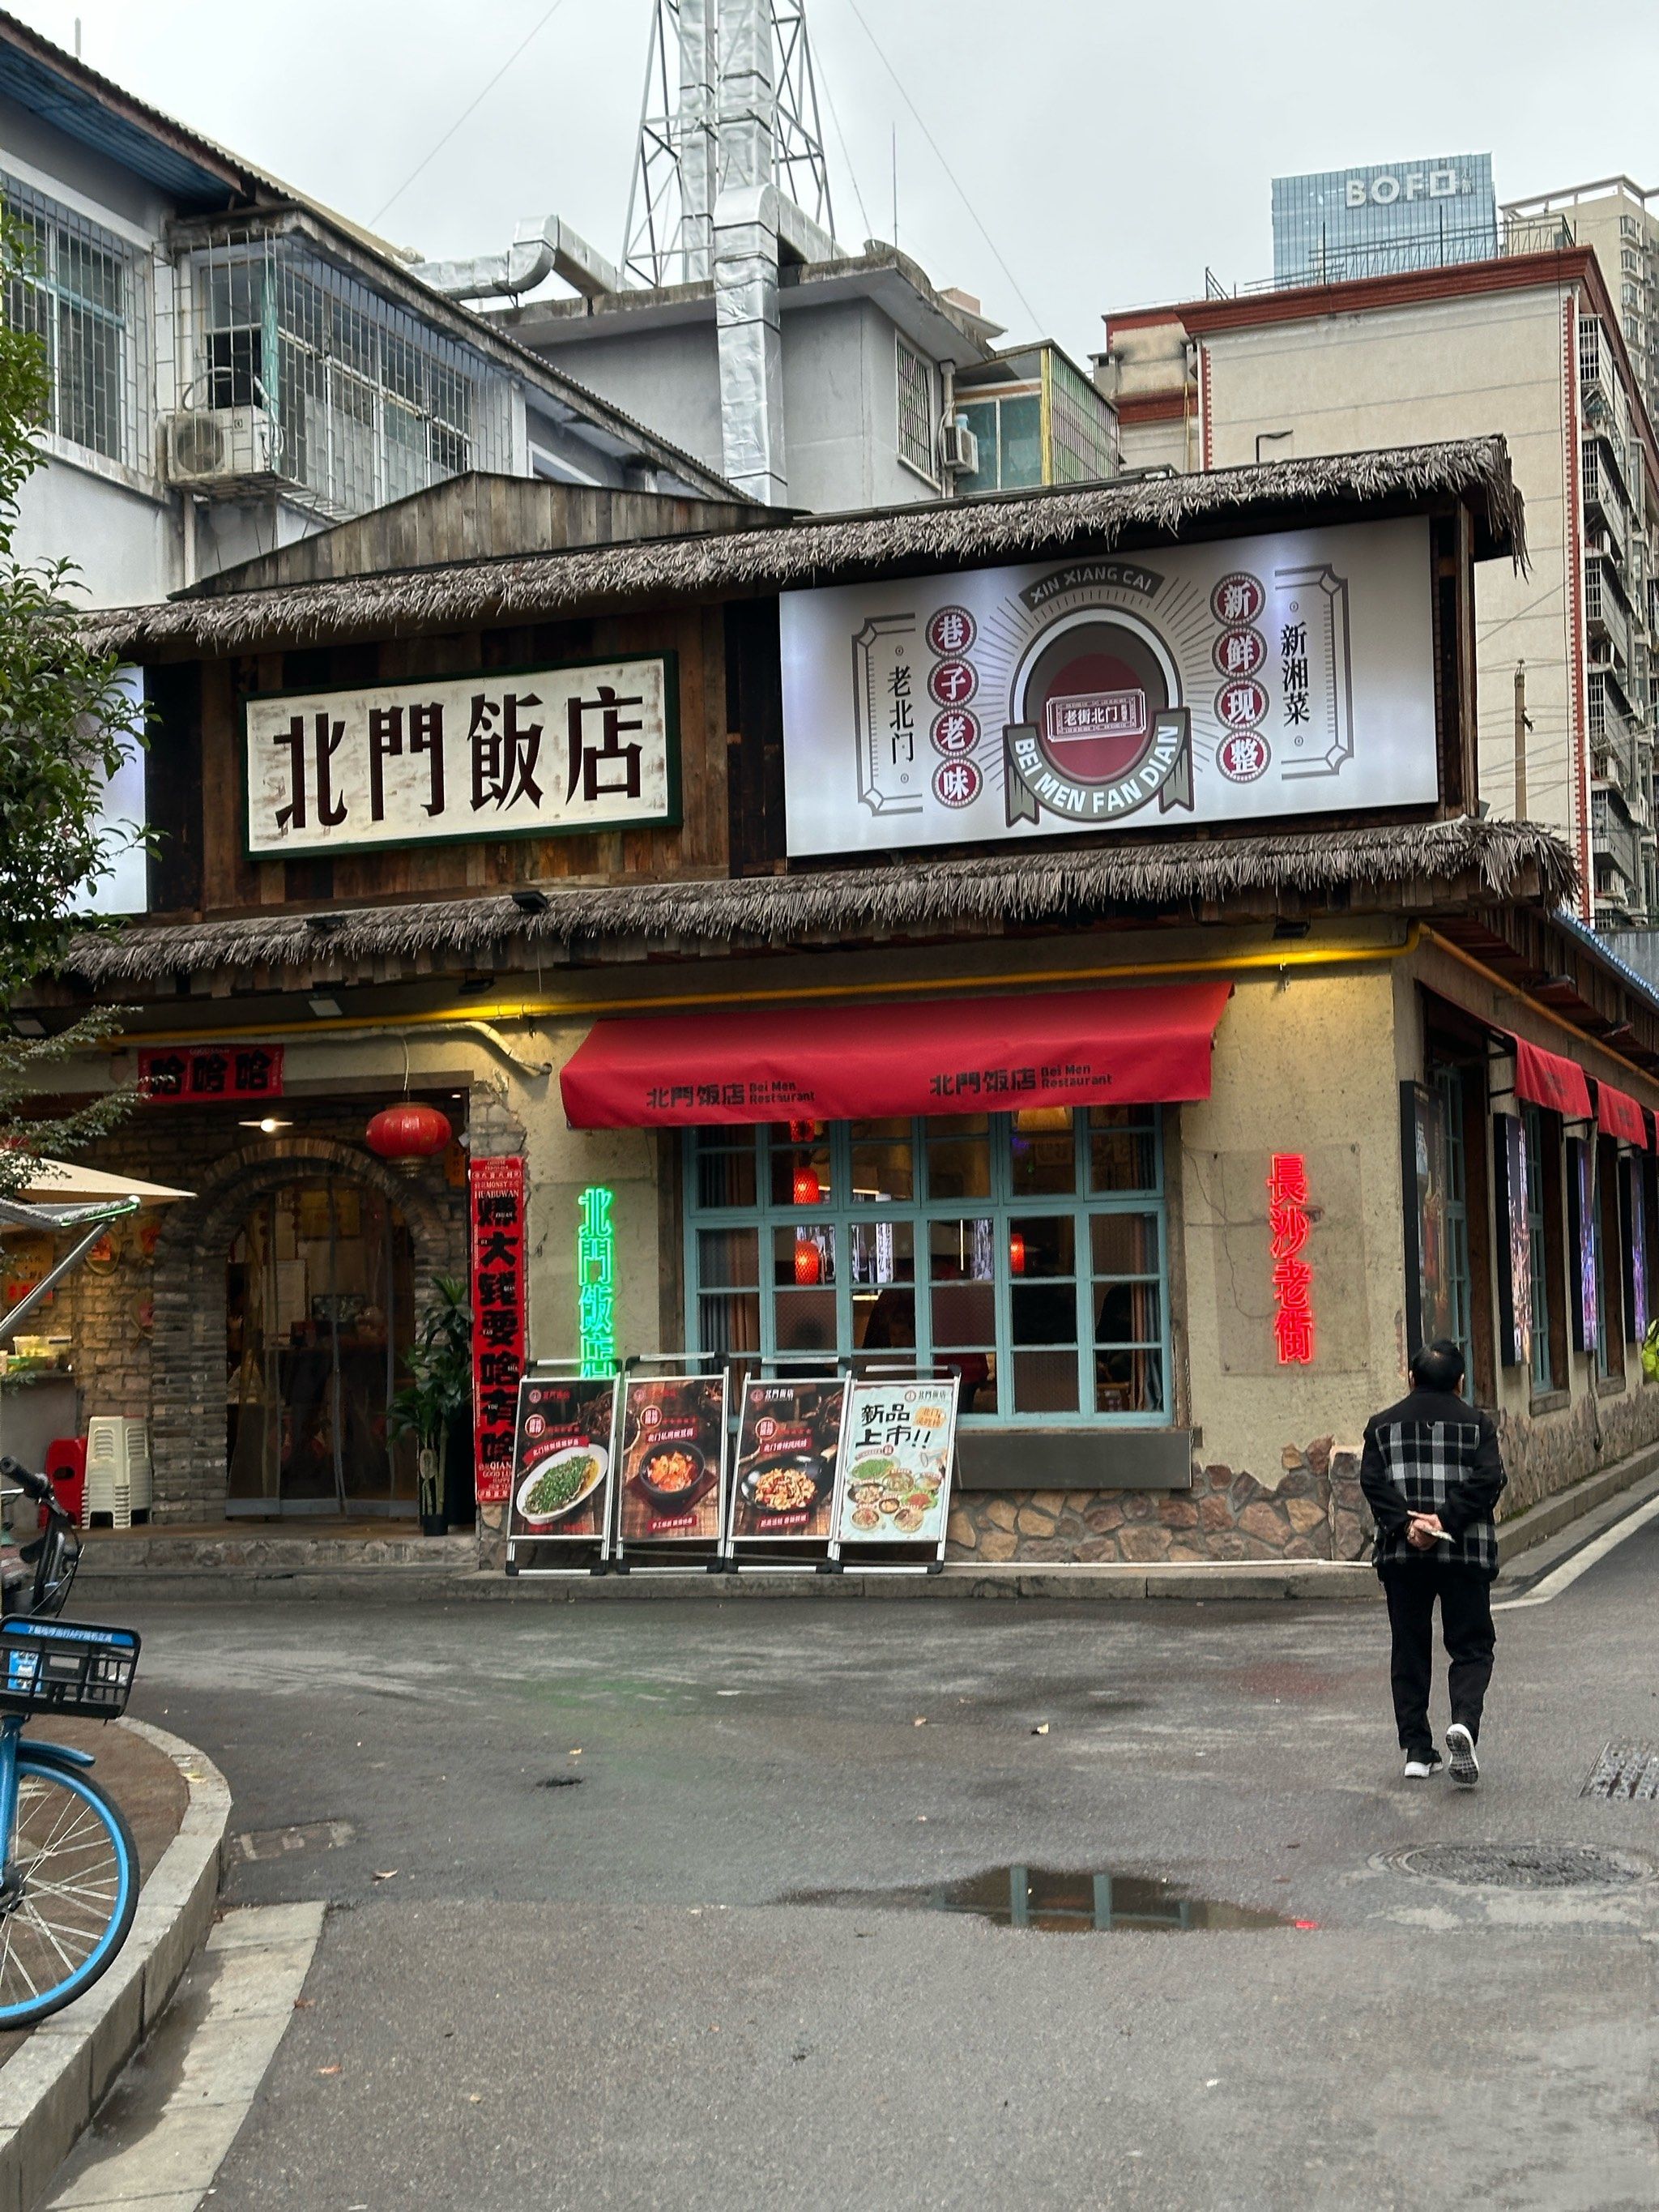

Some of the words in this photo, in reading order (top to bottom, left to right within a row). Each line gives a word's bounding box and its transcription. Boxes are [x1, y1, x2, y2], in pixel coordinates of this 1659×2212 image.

[1030, 578, 1060, 604] XIN
[1063, 566, 1118, 586] XIANG
[1123, 570, 1152, 591] CAI
[887, 664, 915, 765] 老北门
[937, 614, 970, 801] 巷子老味
[1064, 705, 1118, 727] 老街北门
[1223, 581, 1259, 775] 新鲜现整
[1280, 621, 1311, 728] 新湘菜
[272, 685, 644, 831] 北門飯店
[1015, 737, 1043, 778] BEI
[1034, 772, 1086, 813] MEN
[1092, 778, 1143, 813] FAN
[1138, 725, 1179, 789] DIAN
[749, 1083, 768, 1093] Bei
[771, 1080, 796, 1092] Men
[749, 1091, 816, 1105] Restaurant
[1041, 1065, 1062, 1077] Bei
[1065, 1064, 1091, 1075] Men
[1041, 1074, 1112, 1089] Restaurant
[578, 1187, 615, 1380] 北門飯店
[1266, 1153, 1315, 1364] 長沙老街
[861, 1403, 911, 1427] 新品
